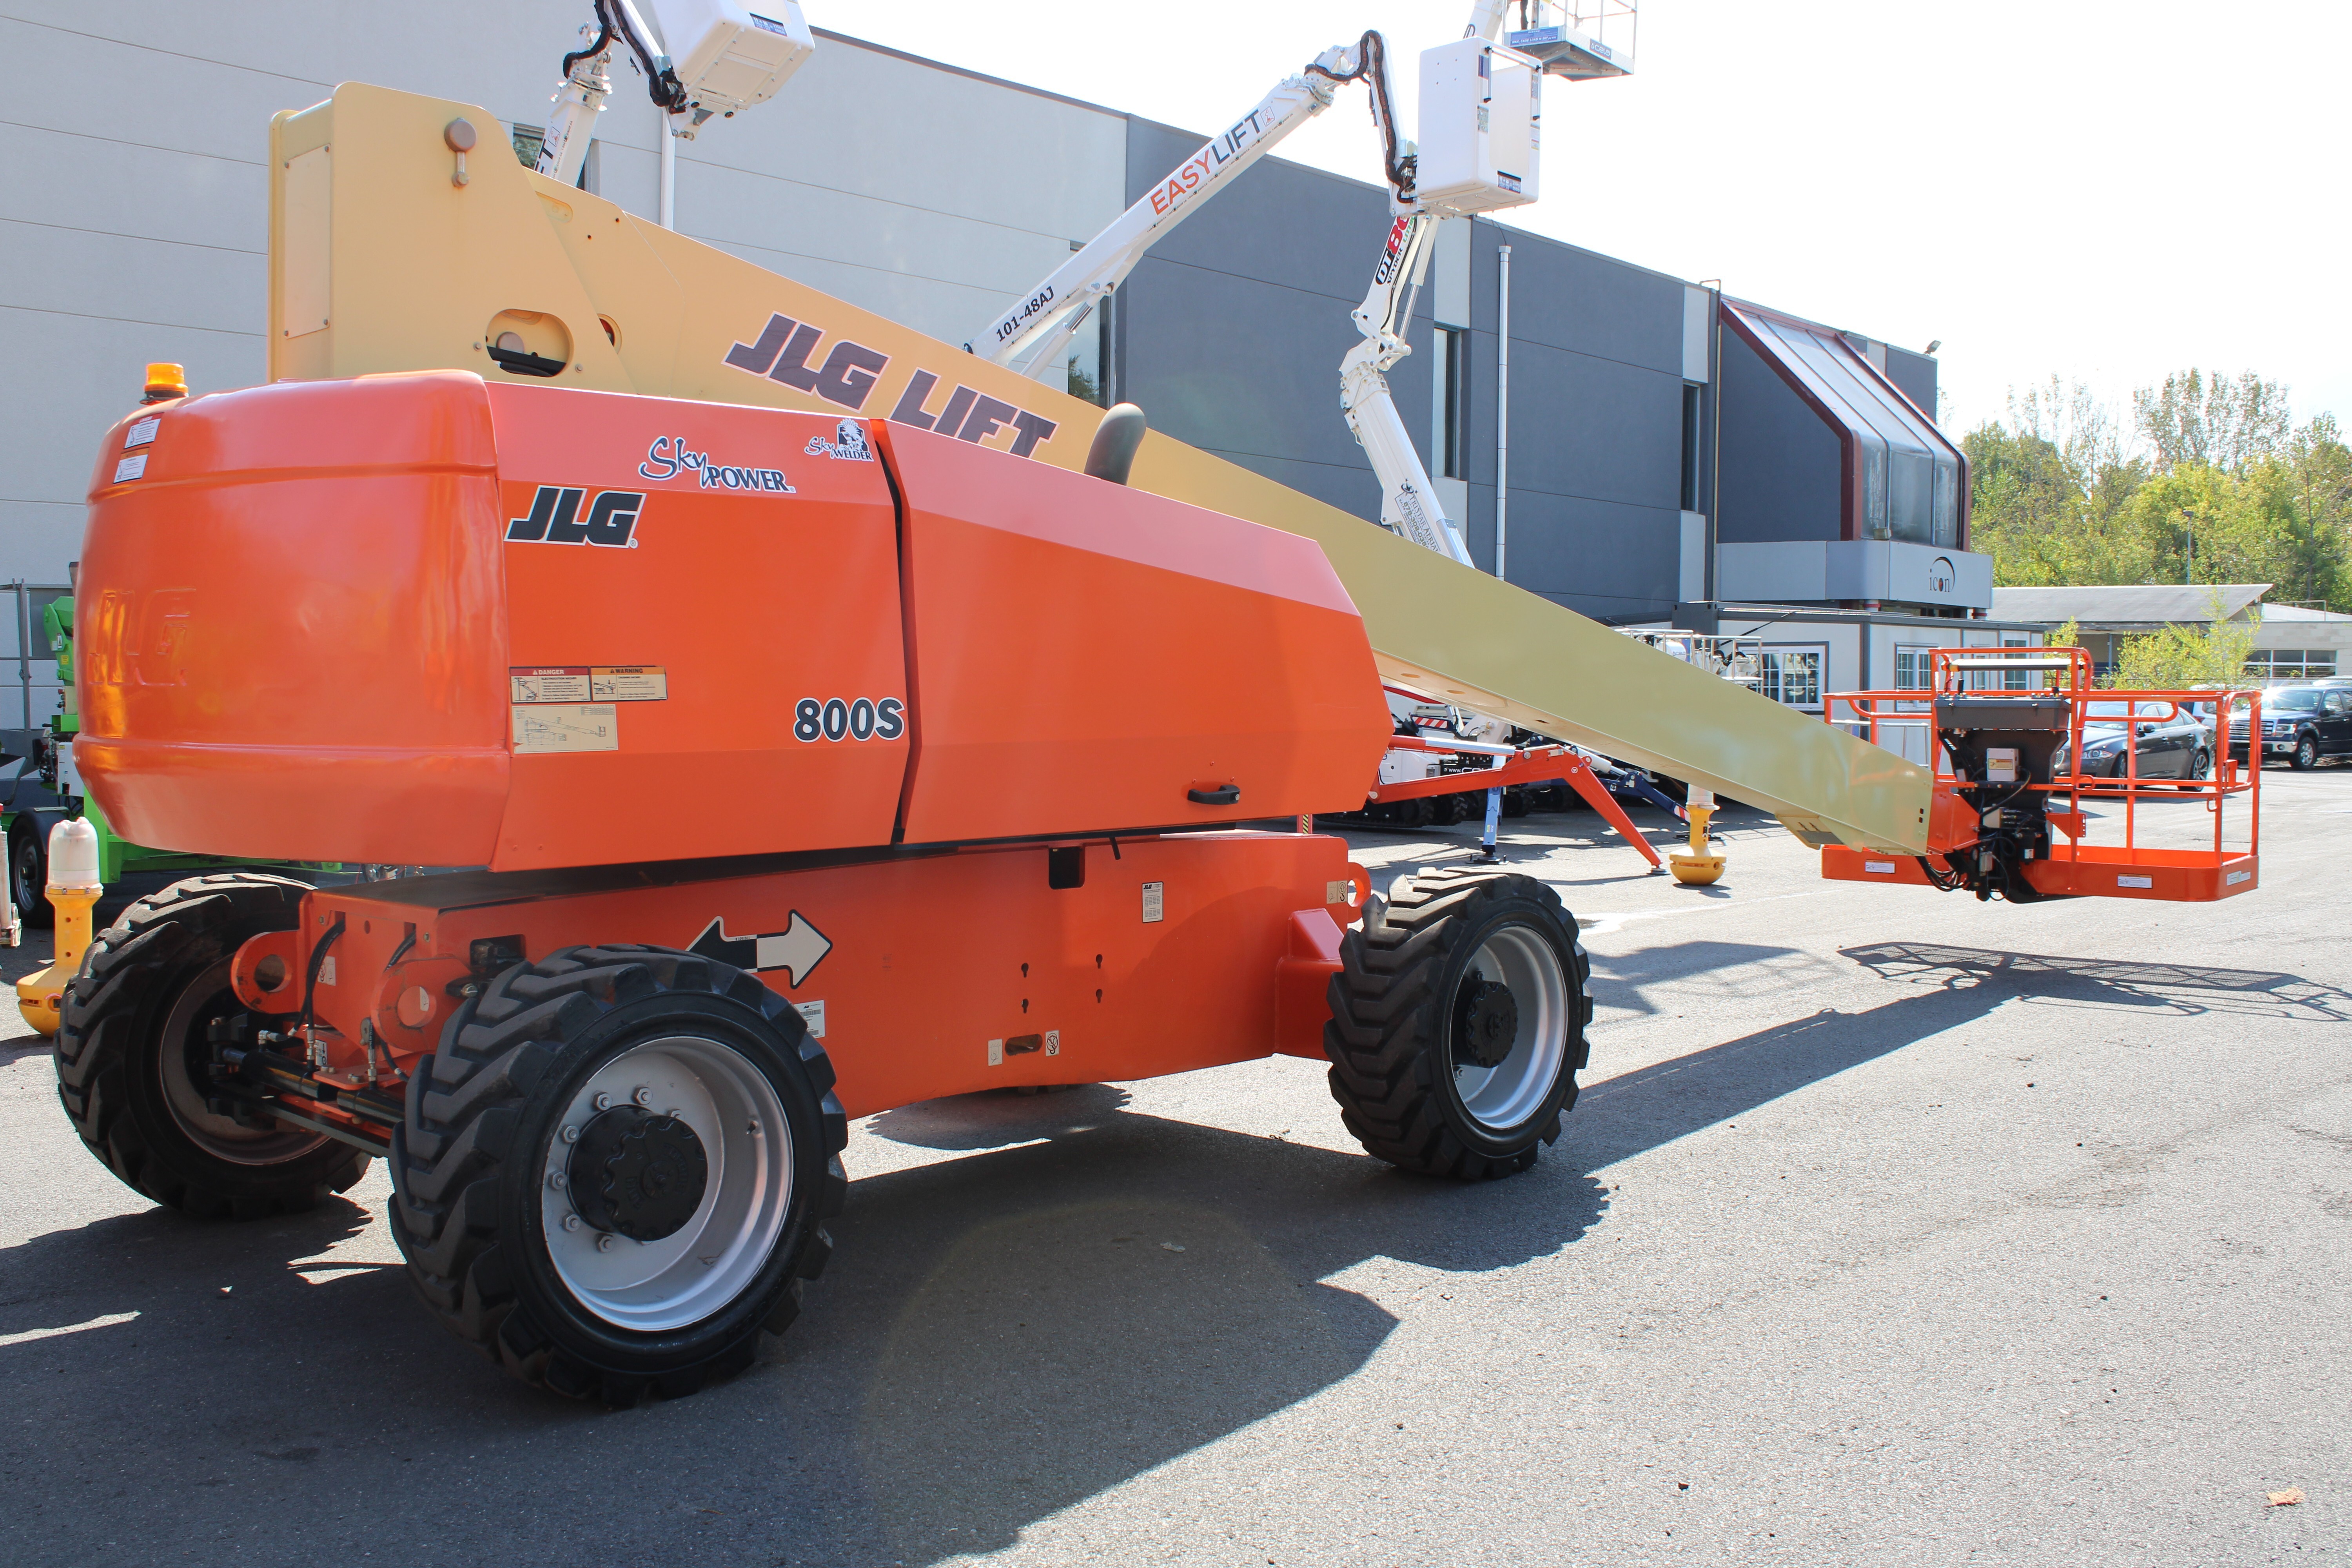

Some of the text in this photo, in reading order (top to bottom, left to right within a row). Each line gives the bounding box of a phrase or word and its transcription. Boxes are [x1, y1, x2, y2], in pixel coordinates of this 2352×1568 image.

[1150, 109, 1261, 215] EASYLIFT
[1387, 247, 1403, 286] SPYDER
[996, 286, 1054, 342] 101-48AJ
[721, 311, 1060, 458] JLG LIFT
[505, 485, 647, 548] JLG
[1929, 568, 1950, 592] icon
[793, 697, 905, 742] 800S
